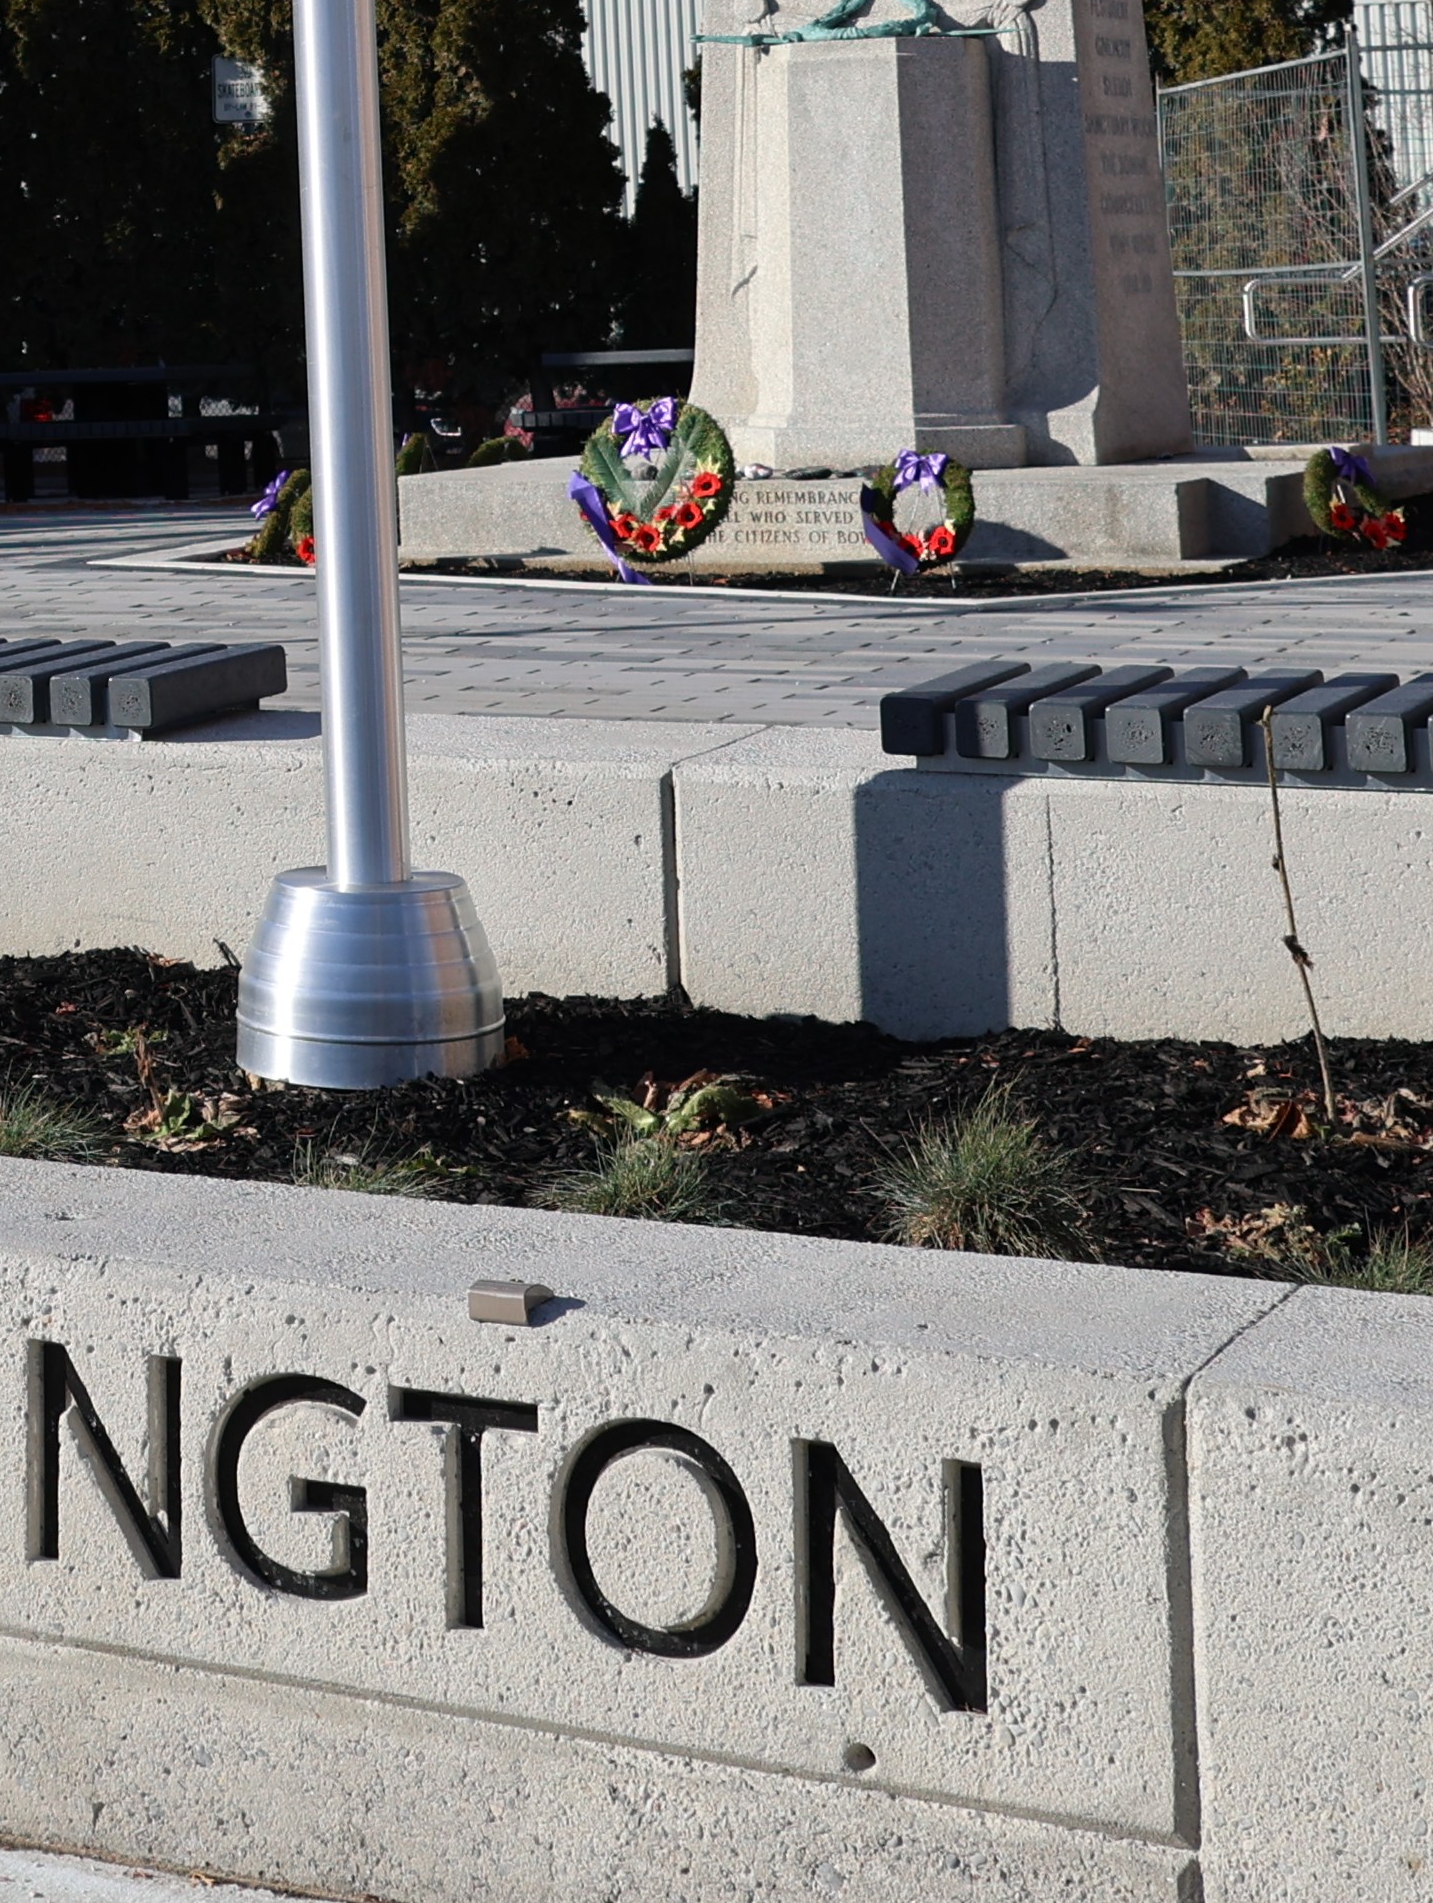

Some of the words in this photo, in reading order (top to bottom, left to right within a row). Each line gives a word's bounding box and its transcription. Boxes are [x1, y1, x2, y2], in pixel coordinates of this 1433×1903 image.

[756, 491, 858, 504] REMEMBRANC
[750, 511, 787, 524] WHO
[796, 511, 853, 524] SERVED
[708, 531, 723, 544] HE
[734, 530, 800, 544] CITIZENS
[809, 530, 828, 544] OF
